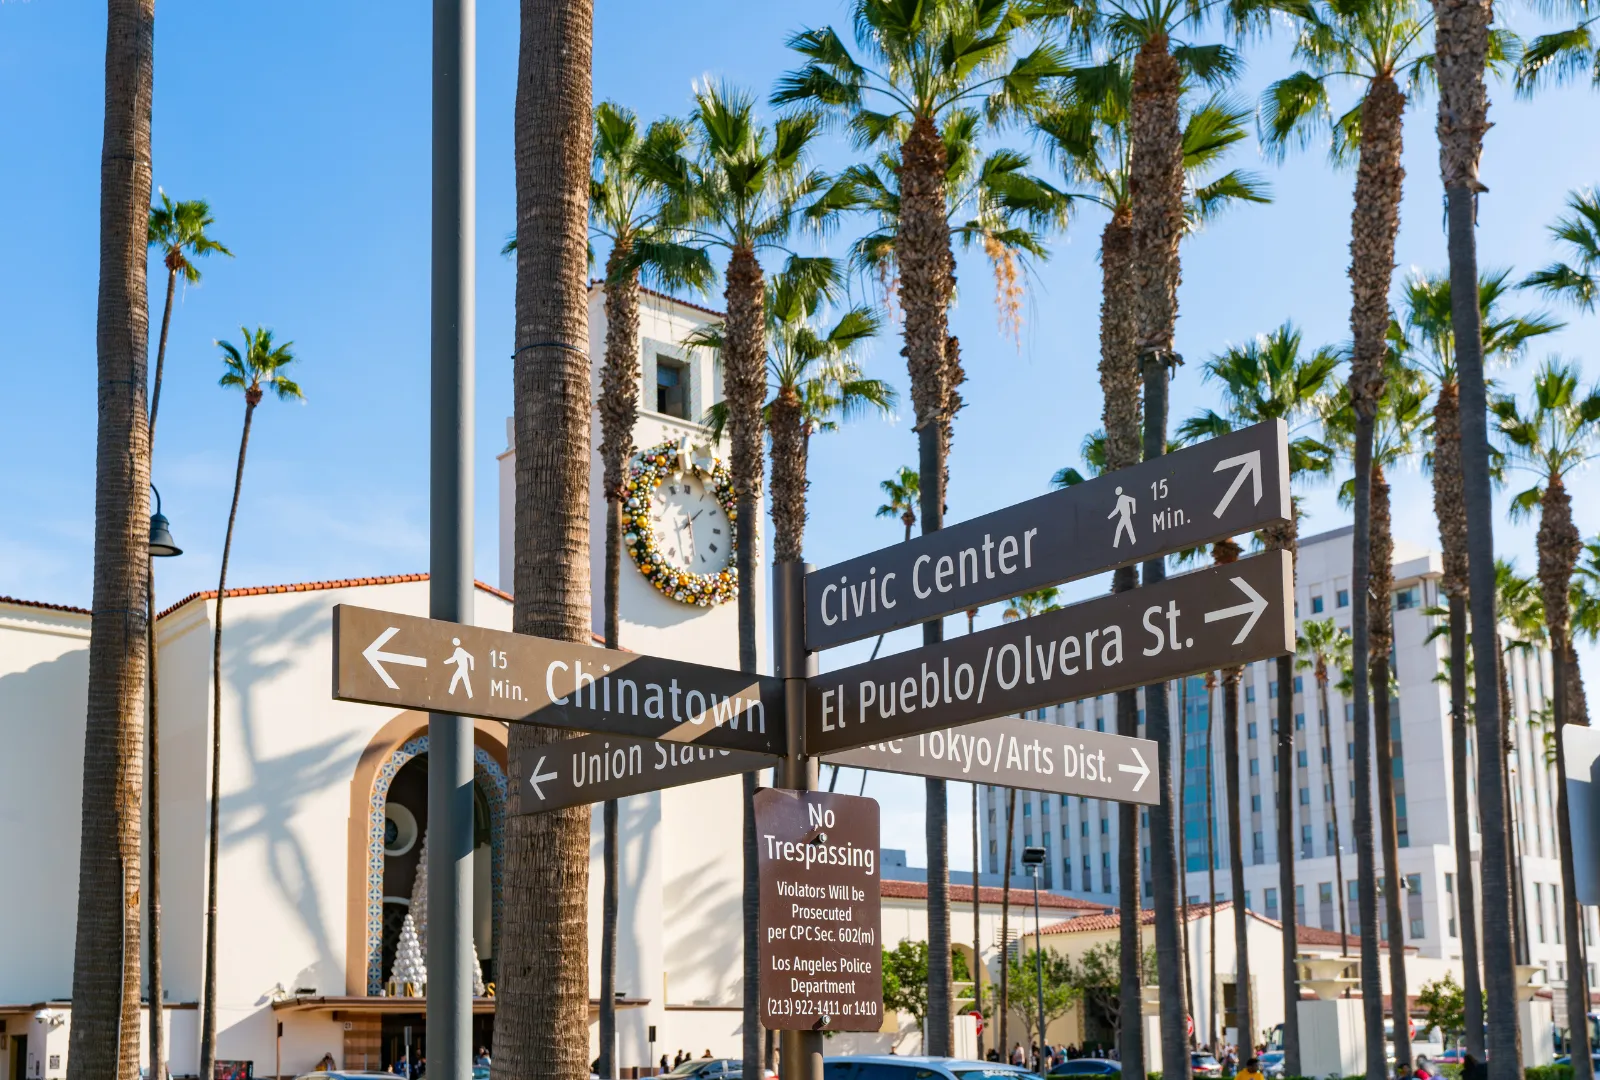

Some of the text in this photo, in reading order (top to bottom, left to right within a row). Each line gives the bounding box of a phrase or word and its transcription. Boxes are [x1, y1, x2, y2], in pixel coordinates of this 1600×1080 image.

[1150, 478, 1169, 501] 15
[1152, 507, 1191, 533] Min.
[820, 527, 1038, 627] Civic Center
[490, 649, 508, 670] 15
[822, 600, 1194, 732] El Pueblo/Olvera St.
[490, 679, 529, 702] Min.
[545, 660, 766, 734] Chinatown
[572, 742, 642, 788] Union
[1063, 743, 1112, 784] Dist.
[808, 803, 835, 829] No
[763, 834, 875, 876] Trespassing
[776, 881, 865, 902] Violators Will be
[792, 903, 852, 922] Prosecuted
[767, 925, 875, 946] per CPC Sec. 602(m)
[772, 955, 872, 976] Los Angeles Police
[791, 977, 856, 997] Department
[767, 997, 877, 1016] (213) 922-1411 or 1410
